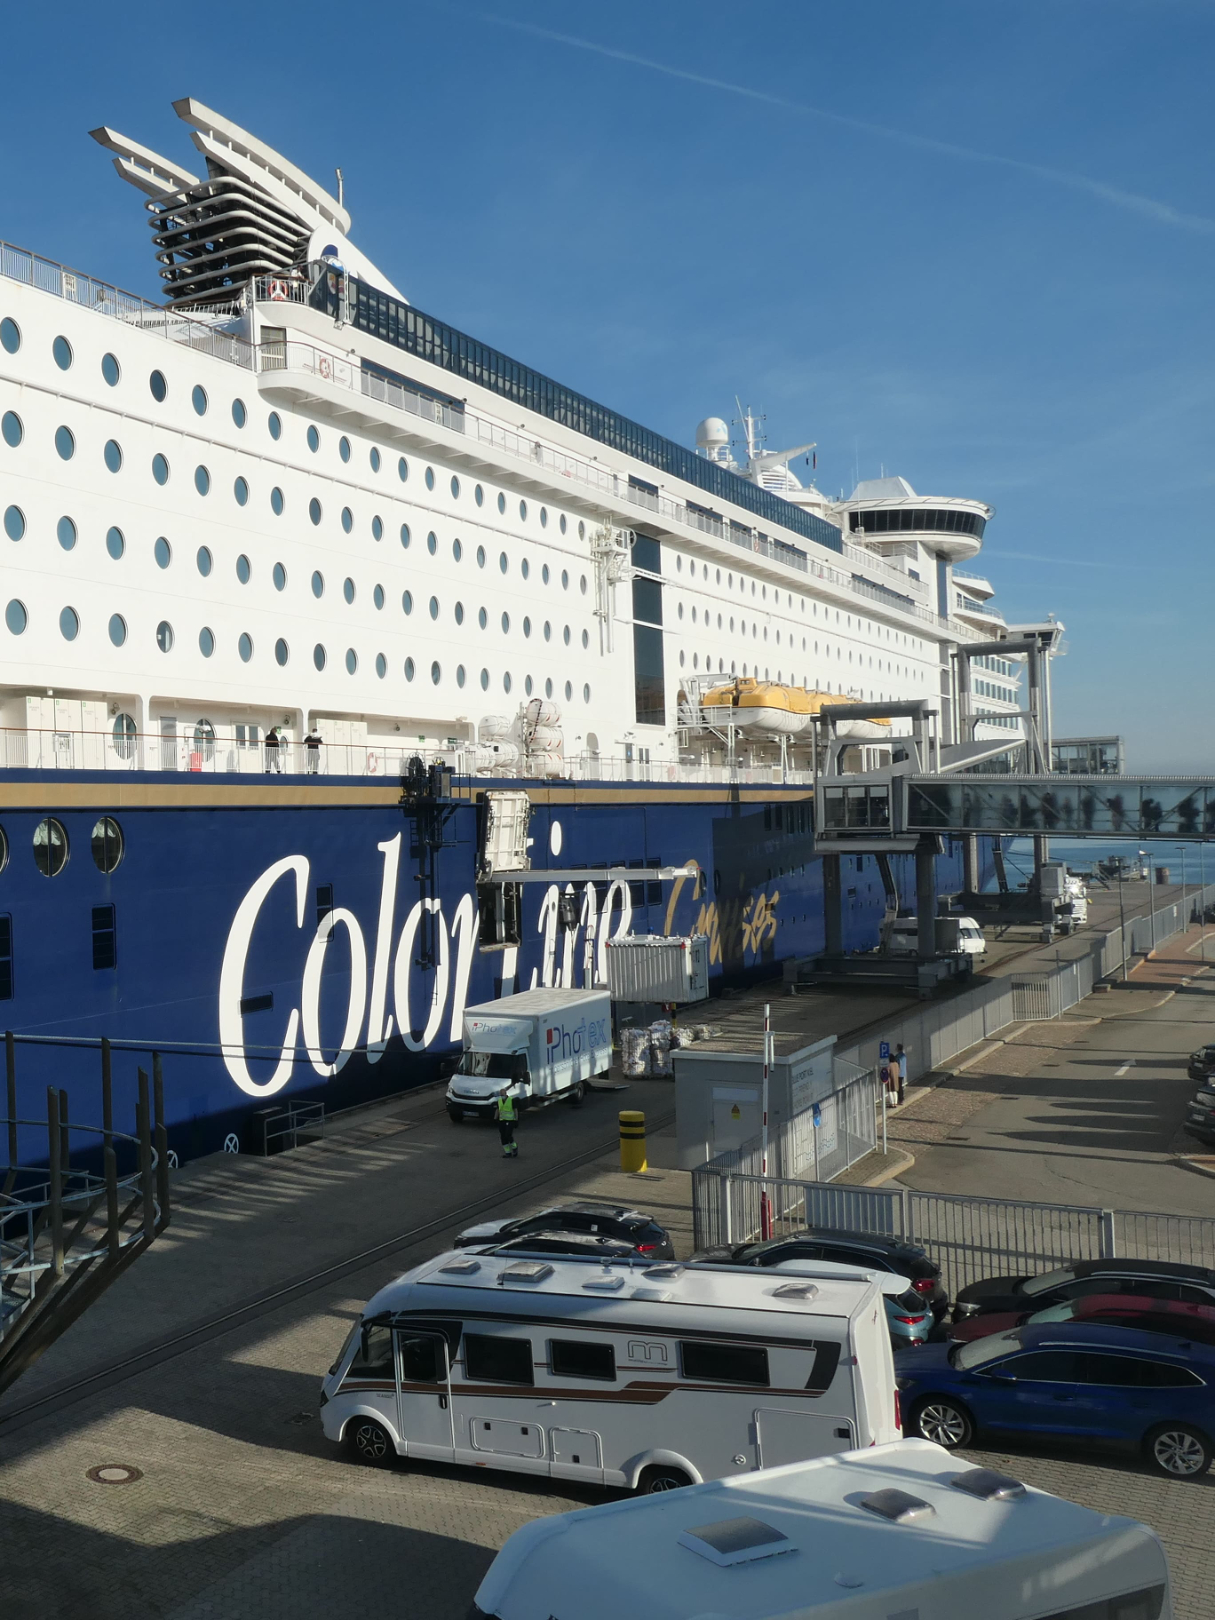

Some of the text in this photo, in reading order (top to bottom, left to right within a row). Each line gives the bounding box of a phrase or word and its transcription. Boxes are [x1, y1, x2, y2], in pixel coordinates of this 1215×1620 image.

[219, 832, 482, 1097] Color
[546, 1017, 607, 1065] iPhotex
[881, 1043, 888, 1057] P
